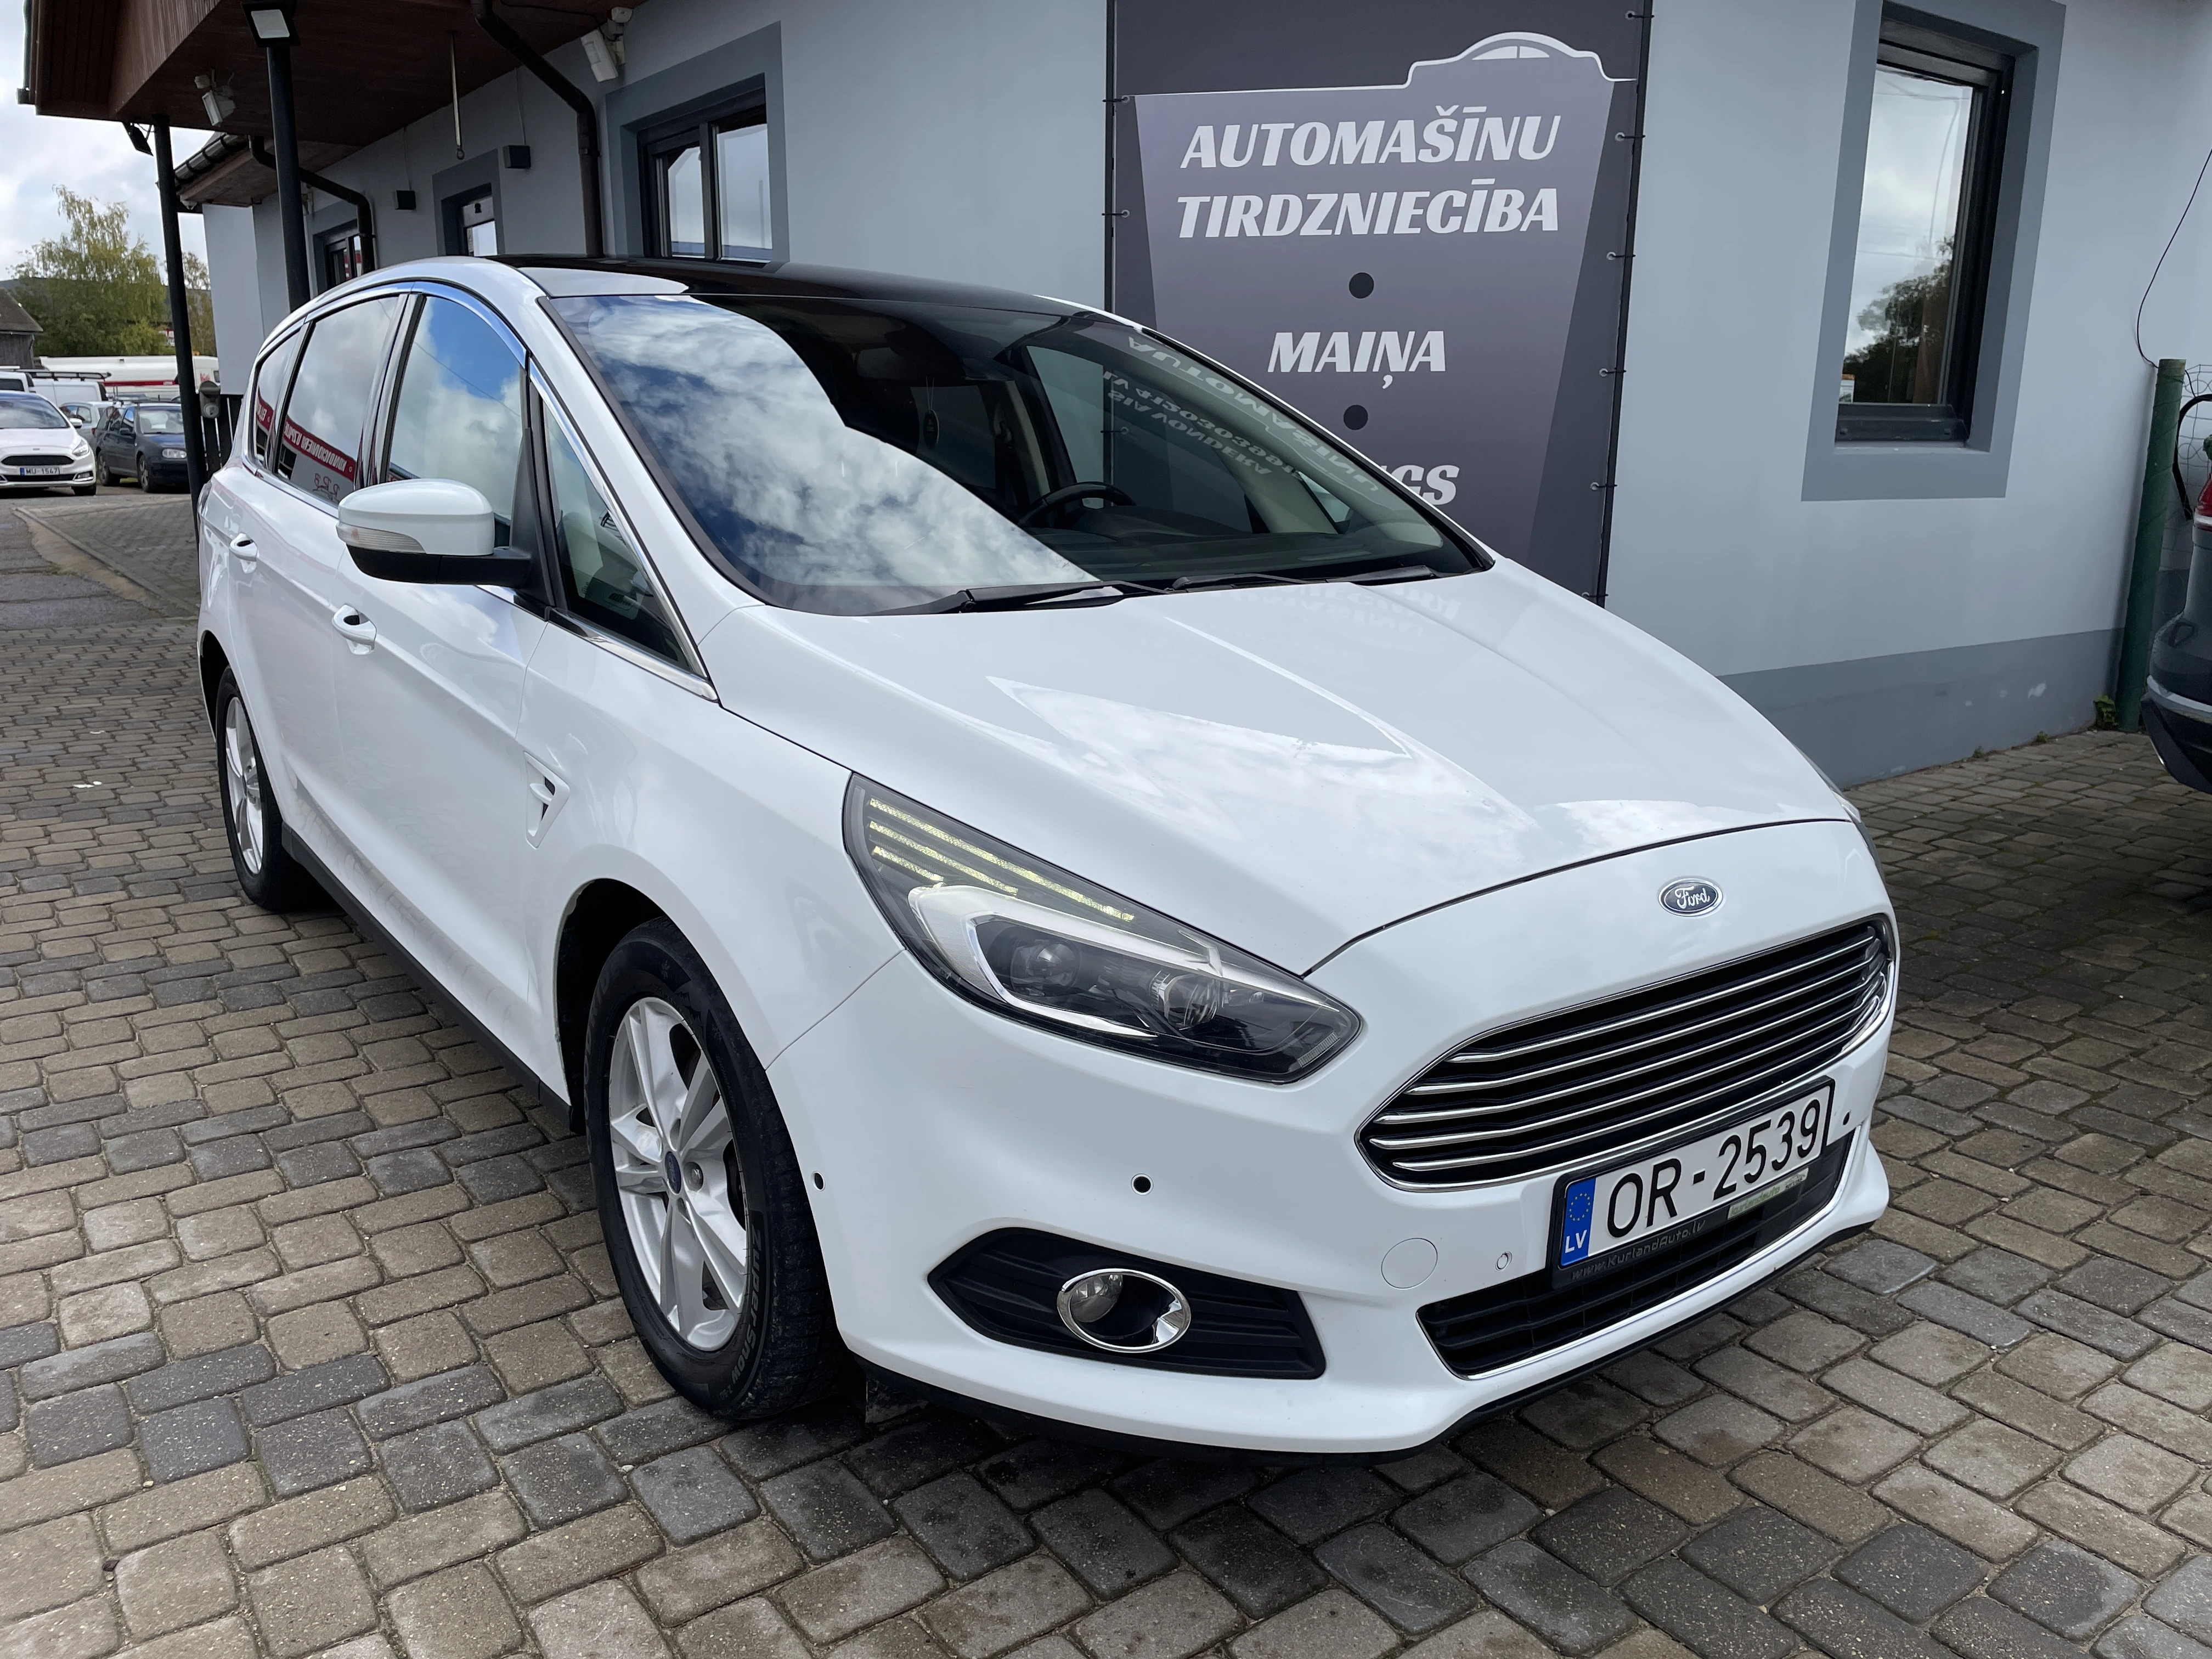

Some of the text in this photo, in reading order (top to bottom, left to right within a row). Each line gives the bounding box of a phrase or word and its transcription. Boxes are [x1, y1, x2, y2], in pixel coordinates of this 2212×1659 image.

[1180, 105, 1561, 169] AUTOMAŠĪNU
[1177, 178, 1559, 238] TIRDZNIECĪBA
[1268, 330, 1447, 389] MAIŅA
[1674, 885, 1710, 909] Ford
[1607, 1099, 1820, 1238] OR-2539
[1565, 1229, 1587, 1254] LV
[1571, 1219, 1706, 1281] www.KurlandAuto.lv
